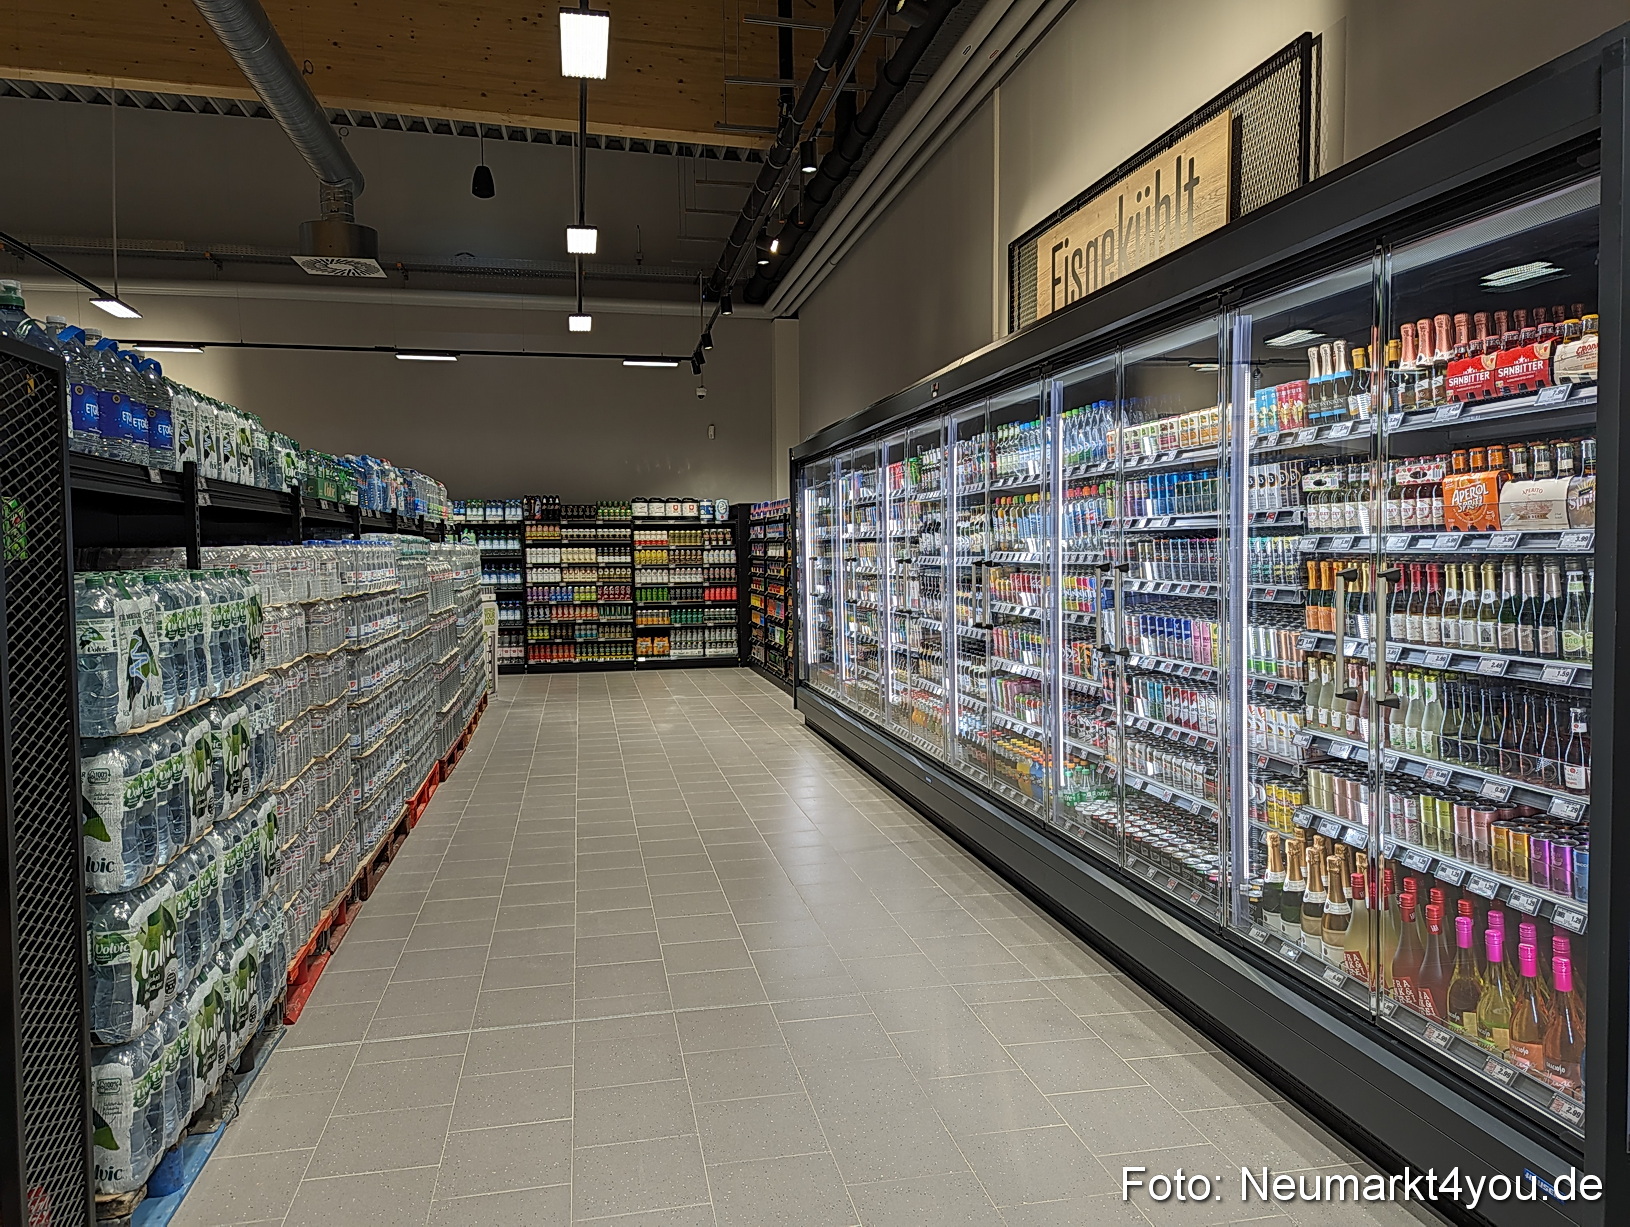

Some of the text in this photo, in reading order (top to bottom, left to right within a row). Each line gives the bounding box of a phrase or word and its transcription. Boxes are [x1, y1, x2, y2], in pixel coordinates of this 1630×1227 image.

[1052, 155, 1200, 313] Eisgekühlt
[1498, 359, 1544, 378] SANBITTER
[1448, 371, 1490, 387] SANBITTER
[1451, 482, 1489, 506] APEROL
[1457, 495, 1483, 512] SPRITZ
[1557, 670, 1570, 678] 1.59
[1495, 786, 1506, 794] 0.89
[1565, 805, 1579, 814] 1.29
[85, 855, 116, 873] lvic
[1570, 915, 1581, 924] 1.29
[95, 941, 130, 955] Volvic
[1435, 1033, 1448, 1042] 2.99
[1498, 1067, 1512, 1078] 2.99
[1566, 1106, 1582, 1119] 2.99
[94, 1164, 124, 1181] lvic
